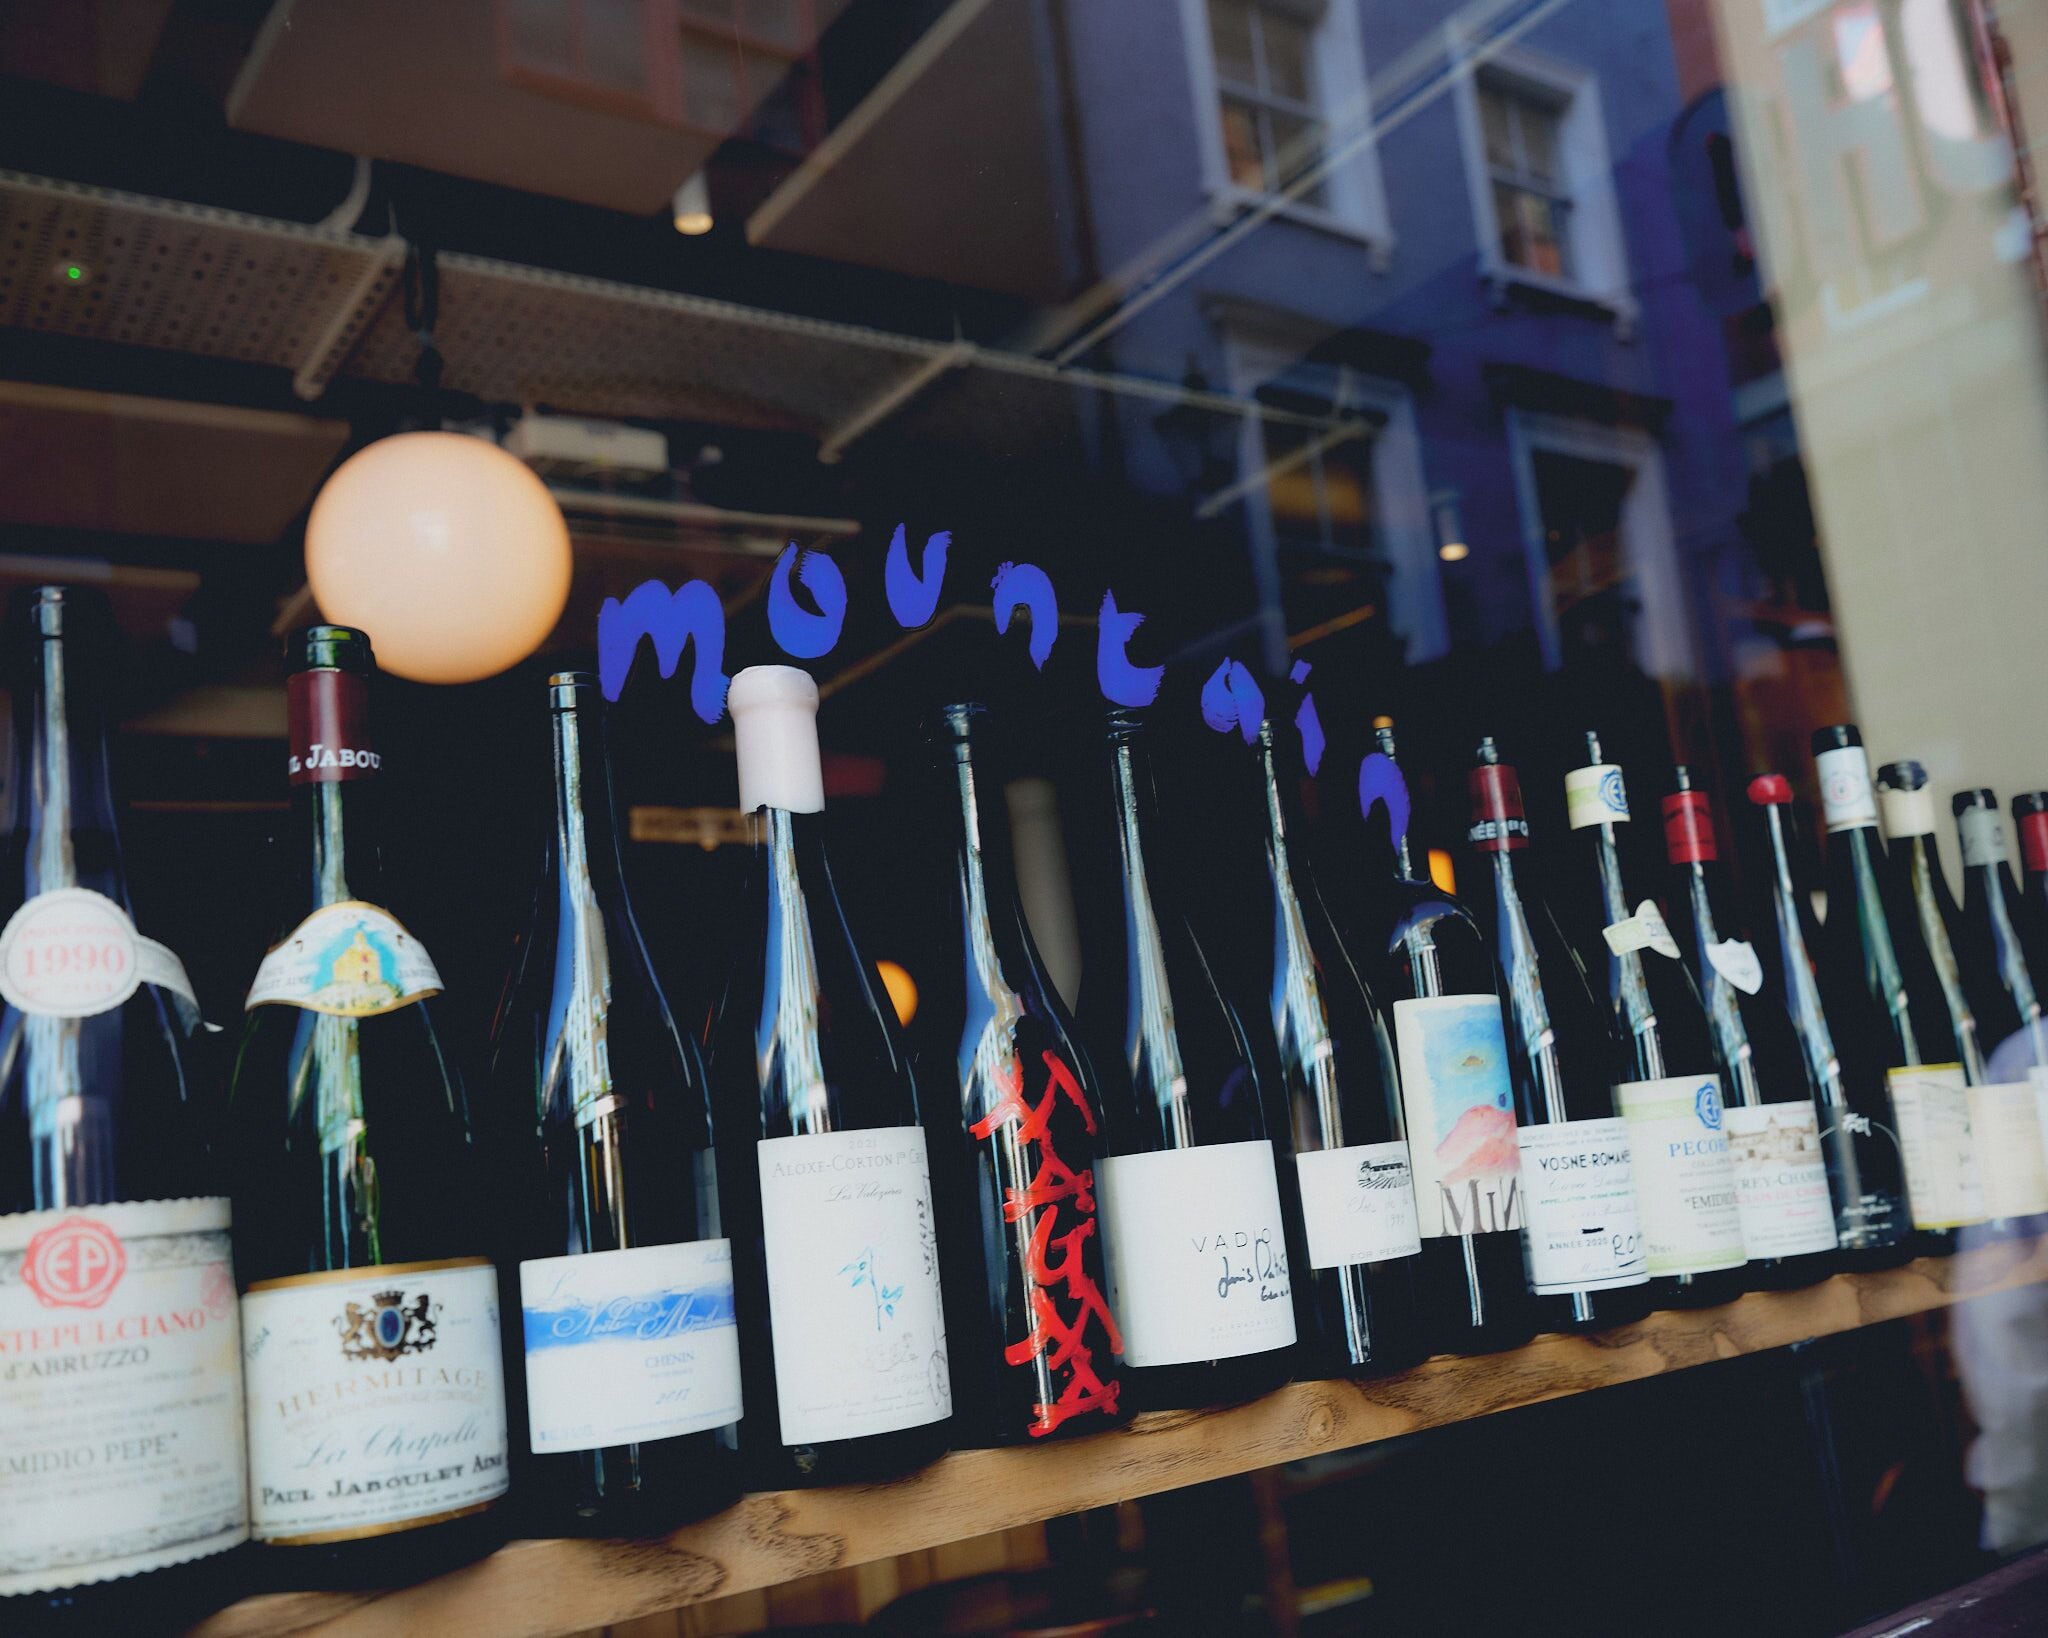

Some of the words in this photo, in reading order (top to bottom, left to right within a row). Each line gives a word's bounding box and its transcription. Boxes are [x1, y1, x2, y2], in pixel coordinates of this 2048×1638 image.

[24, 943, 125, 978] 1990
[847, 1138, 877, 1150] 2021
[645, 1350, 696, 1369] CHENIN
[277, 1366, 489, 1418] HERMITAGE
